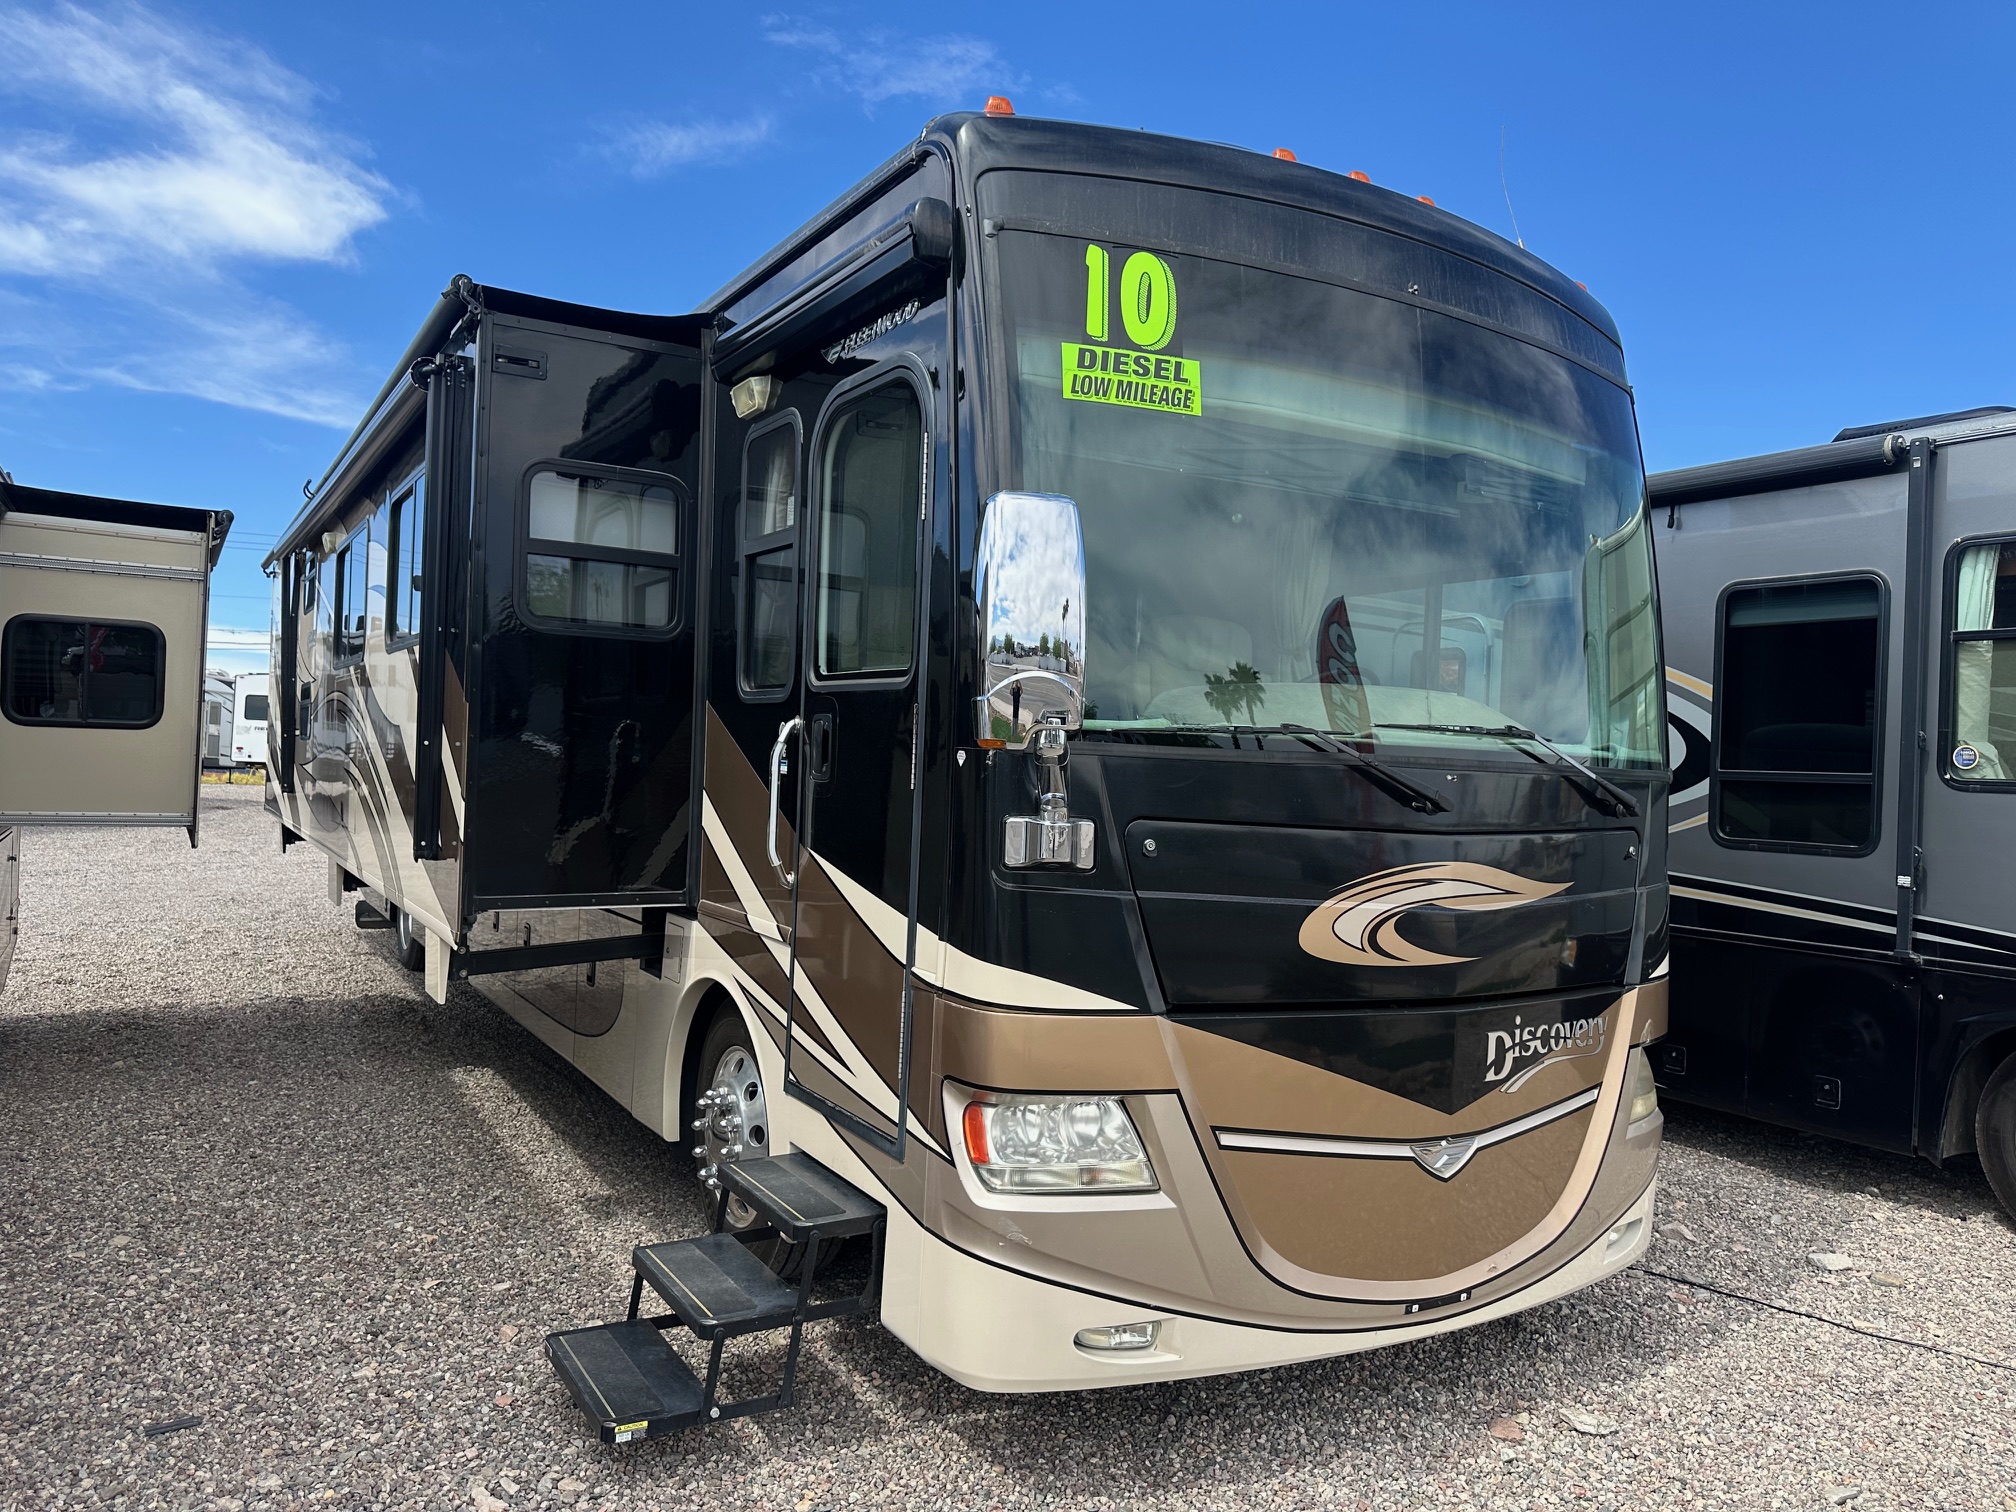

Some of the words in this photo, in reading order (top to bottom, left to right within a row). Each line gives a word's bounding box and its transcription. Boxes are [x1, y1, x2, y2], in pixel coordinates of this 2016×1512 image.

[1085, 243, 1177, 350] 10
[843, 298, 919, 356] FLEETWOOD
[1076, 347, 1191, 386] DIESEL
[1070, 373, 1115, 401] LOW
[1114, 378, 1196, 413] MILEAGE
[1484, 1014, 1609, 1082] Discovery
[623, 1422, 644, 1430] CAUTION
